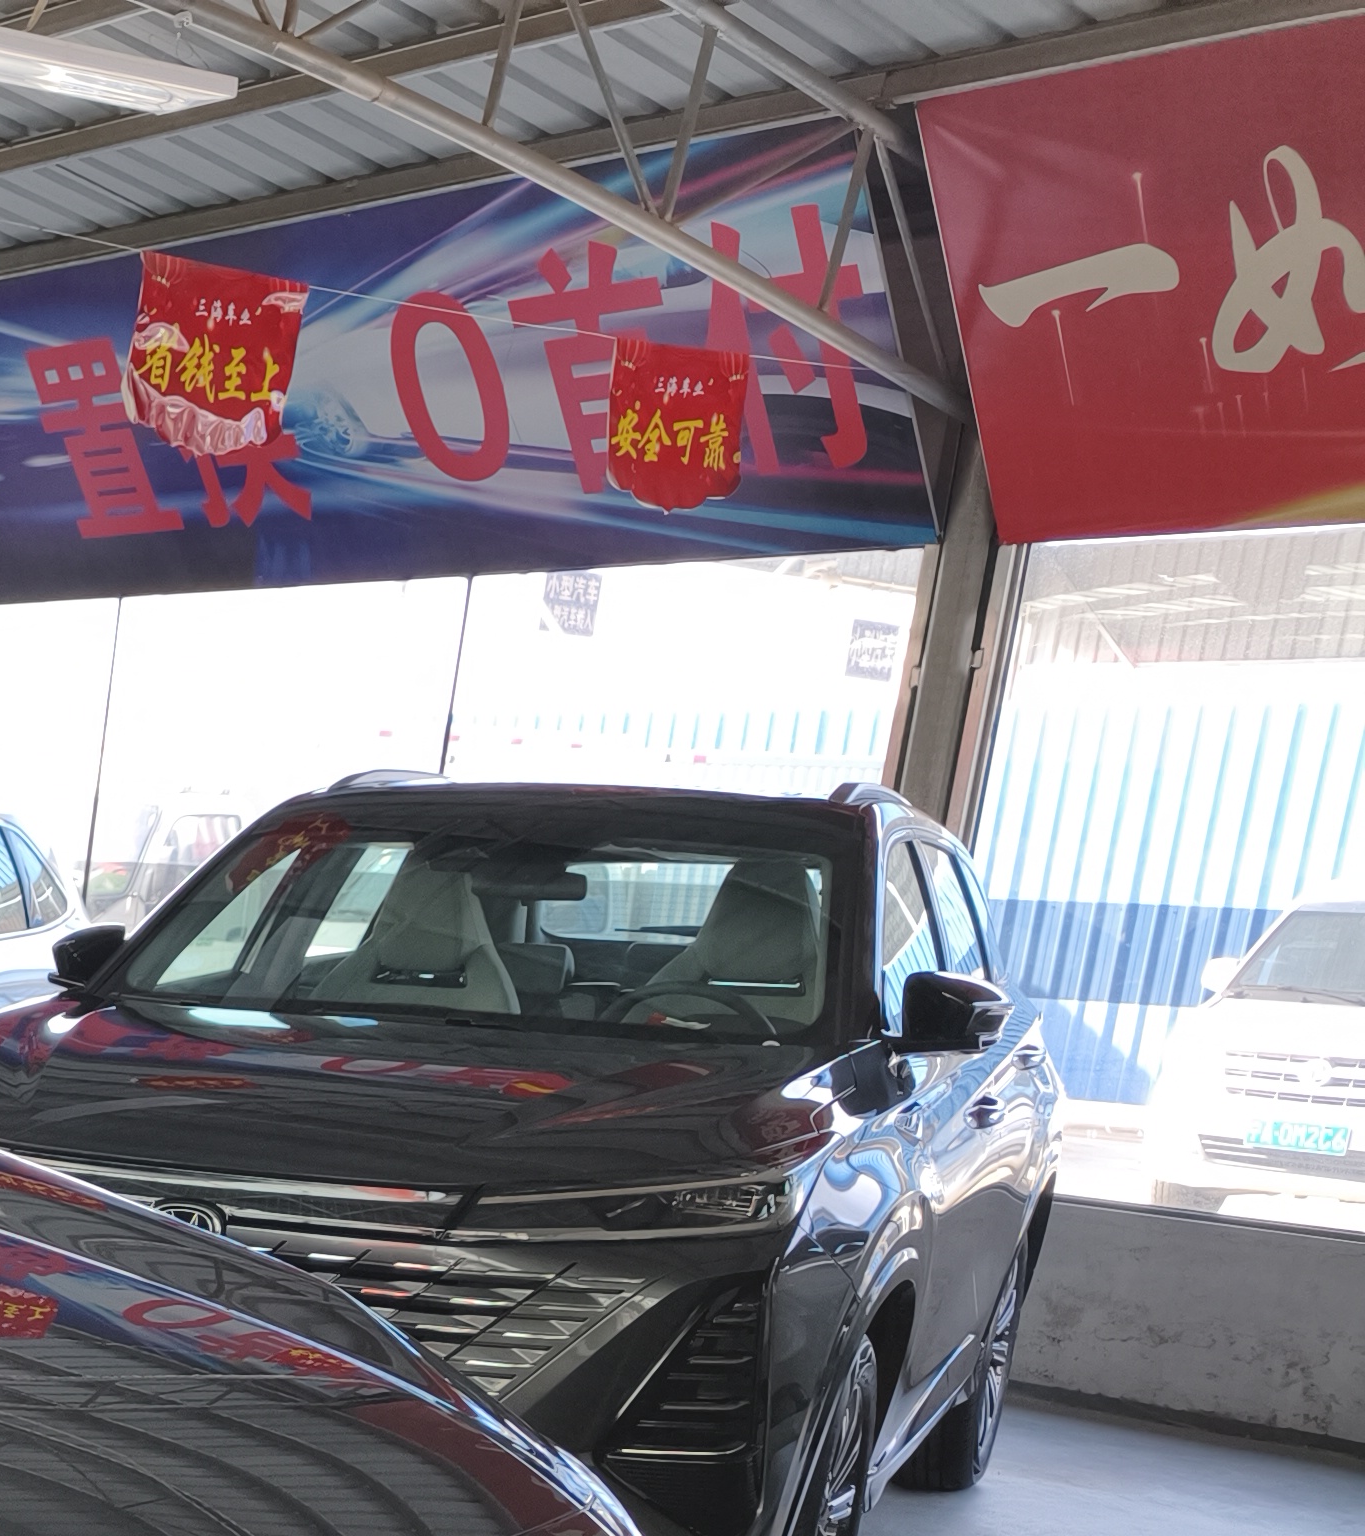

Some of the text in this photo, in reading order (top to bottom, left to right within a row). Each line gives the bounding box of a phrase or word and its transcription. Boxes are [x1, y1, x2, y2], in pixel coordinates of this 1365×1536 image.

[195, 298, 252, 326] 三海车业
[135, 325, 280, 403] 省钱至上
[611, 409, 729, 472] 安全可靠
[547, 575, 599, 605] 小型汽车
